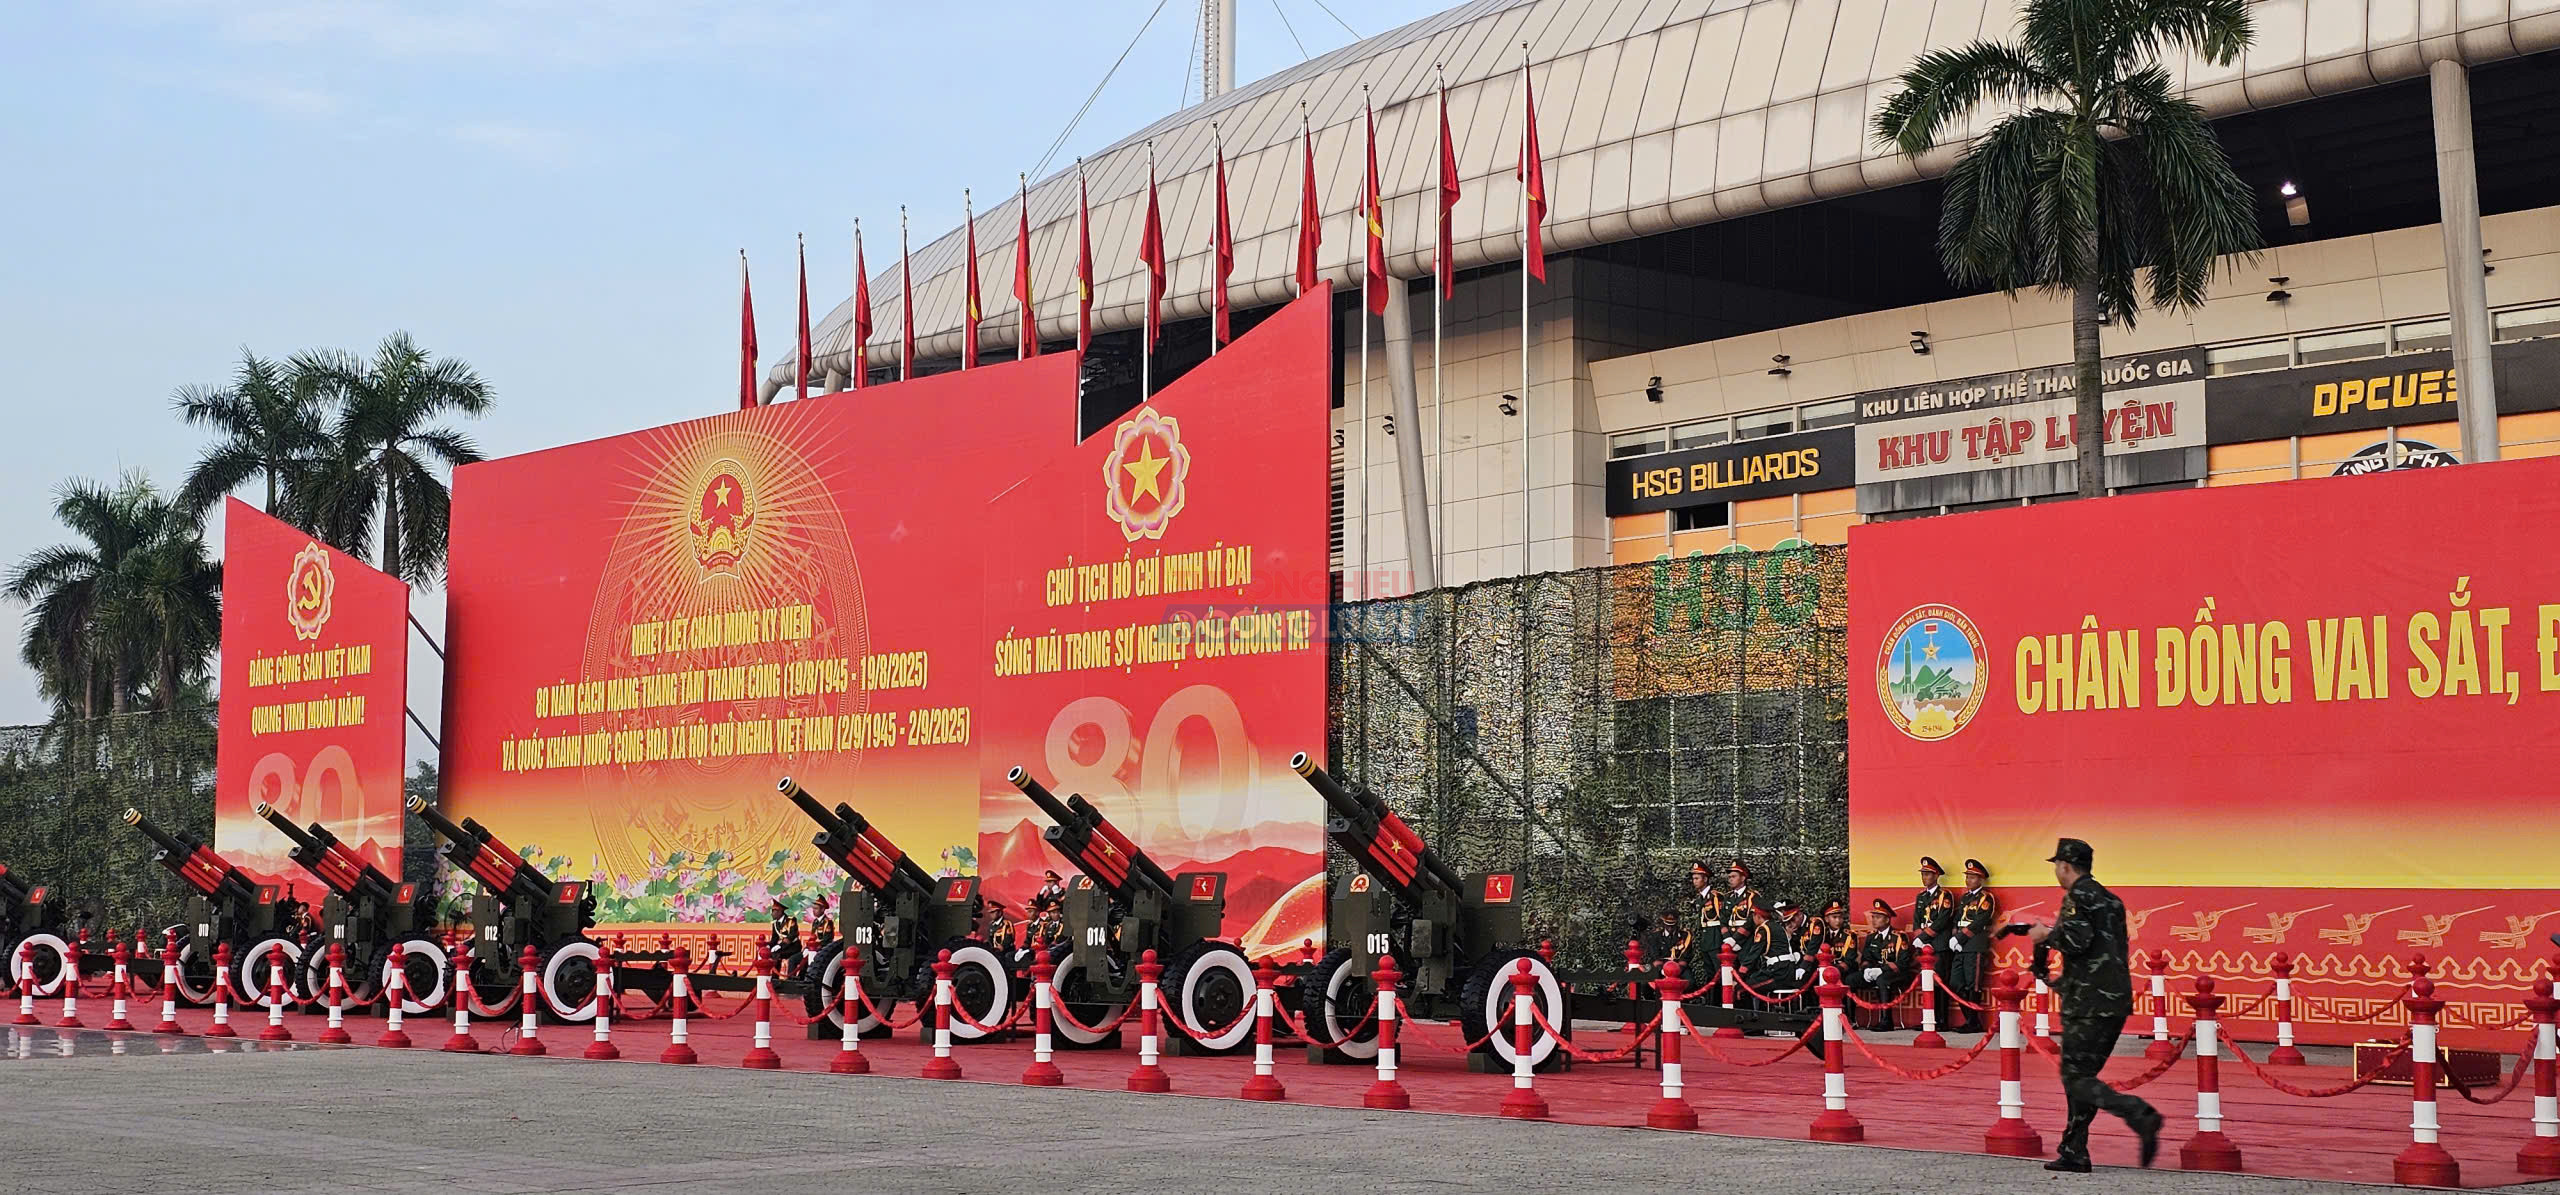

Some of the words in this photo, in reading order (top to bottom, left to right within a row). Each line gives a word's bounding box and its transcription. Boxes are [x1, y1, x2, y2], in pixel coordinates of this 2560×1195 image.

[1862, 399, 1899, 418] KHU
[1904, 391, 1944, 413] LIÊN
[1948, 387, 1986, 410] HỢP
[1991, 371, 2028, 402] THỂ
[2033, 375, 2077, 396] THA
[2157, 358, 2194, 378] GIA
[1878, 430, 1951, 471] KHU
[1961, 416, 2035, 463] TẬP
[1632, 467, 1683, 500] HSG
[1690, 448, 1821, 492] BILLIARDS
[1046, 555, 1074, 607] CHỦ
[1078, 563, 1109, 612] TỊCH
[1112, 547, 1132, 600] HỒ
[1136, 549, 1160, 597] CHÍ
[1164, 551, 1203, 594] MINH
[1207, 541, 1223, 589] VĨ
[1226, 545, 1252, 596] ĐẠI
[1653, 539, 1819, 637] HSG
[632, 615, 663, 661] NHIỆT
[666, 613, 688, 658] LIỆT
[691, 608, 720, 650] CHÀO
[724, 605, 758, 647] MỪNG
[762, 597, 777, 642] KỶ
[780, 599, 812, 647] NIỆM
[994, 626, 1032, 677] SỐNG
[1035, 628, 1062, 673] MÃI
[1065, 629, 1111, 671] TRONG
[1114, 623, 1136, 674] SỰ
[1137, 614, 1191, 670] NGHIỆP
[1195, 605, 1225, 660] CỦA
[1229, 605, 1282, 656] CHÚNG
[1286, 609, 1311, 651] TA!
[2016, 614, 2140, 714] CHÂN
[2154, 596, 2292, 707] ĐỒNG
[2307, 614, 2389, 702] VAI
[2407, 576, 2519, 705] SẮT,
[249, 650, 273, 687] ĐẢNG
[276, 650, 300, 690] CỘNG
[303, 643, 322, 681] SẢN
[325, 643, 345, 684] VIỆT
[347, 645, 370, 675] NAM
[536, 687, 549, 718] 80
[551, 679, 574, 717] NĂM
[577, 676, 604, 714] CÁCH
[608, 677, 639, 718] MẠNG
[642, 668, 677, 708] THÁNG
[680, 664, 704, 704] TÁM
[708, 661, 745, 701] THÀNH
[749, 658, 780, 698] CÔNG
[784, 658, 848, 699] (19/8/1945
[860, 651, 928, 691] 19/8/2025)
[252, 705, 281, 737] QUANG
[284, 702, 305, 732] VINH
[308, 693, 336, 729] MUÔN
[338, 691, 364, 726] NĂM!
[503, 734, 515, 771] VÀ
[517, 728, 544, 774] QUỐC
[547, 730, 581, 768] KHÁNH
[584, 727, 611, 765] NƯỚC
[615, 724, 643, 770] CỘNG
[647, 721, 667, 760] HÒA
[671, 721, 685, 759] XÃ
[689, 718, 708, 764] HỘI
[711, 711, 734, 756] CHỦ
[737, 714, 772, 755] NGHĨA
[777, 711, 802, 760] VIỆT
[804, 716, 833, 752] NAM
[837, 712, 896, 753] (2/9/1945
[908, 707, 970, 747] 2/9/2025)
[1038, 684, 1256, 868] 80
[333, 924, 345, 939] 011
[484, 925, 498, 941] 012
[856, 926, 873, 944] 013
[1087, 927, 1106, 946] 014
[1367, 933, 1389, 954] 015
